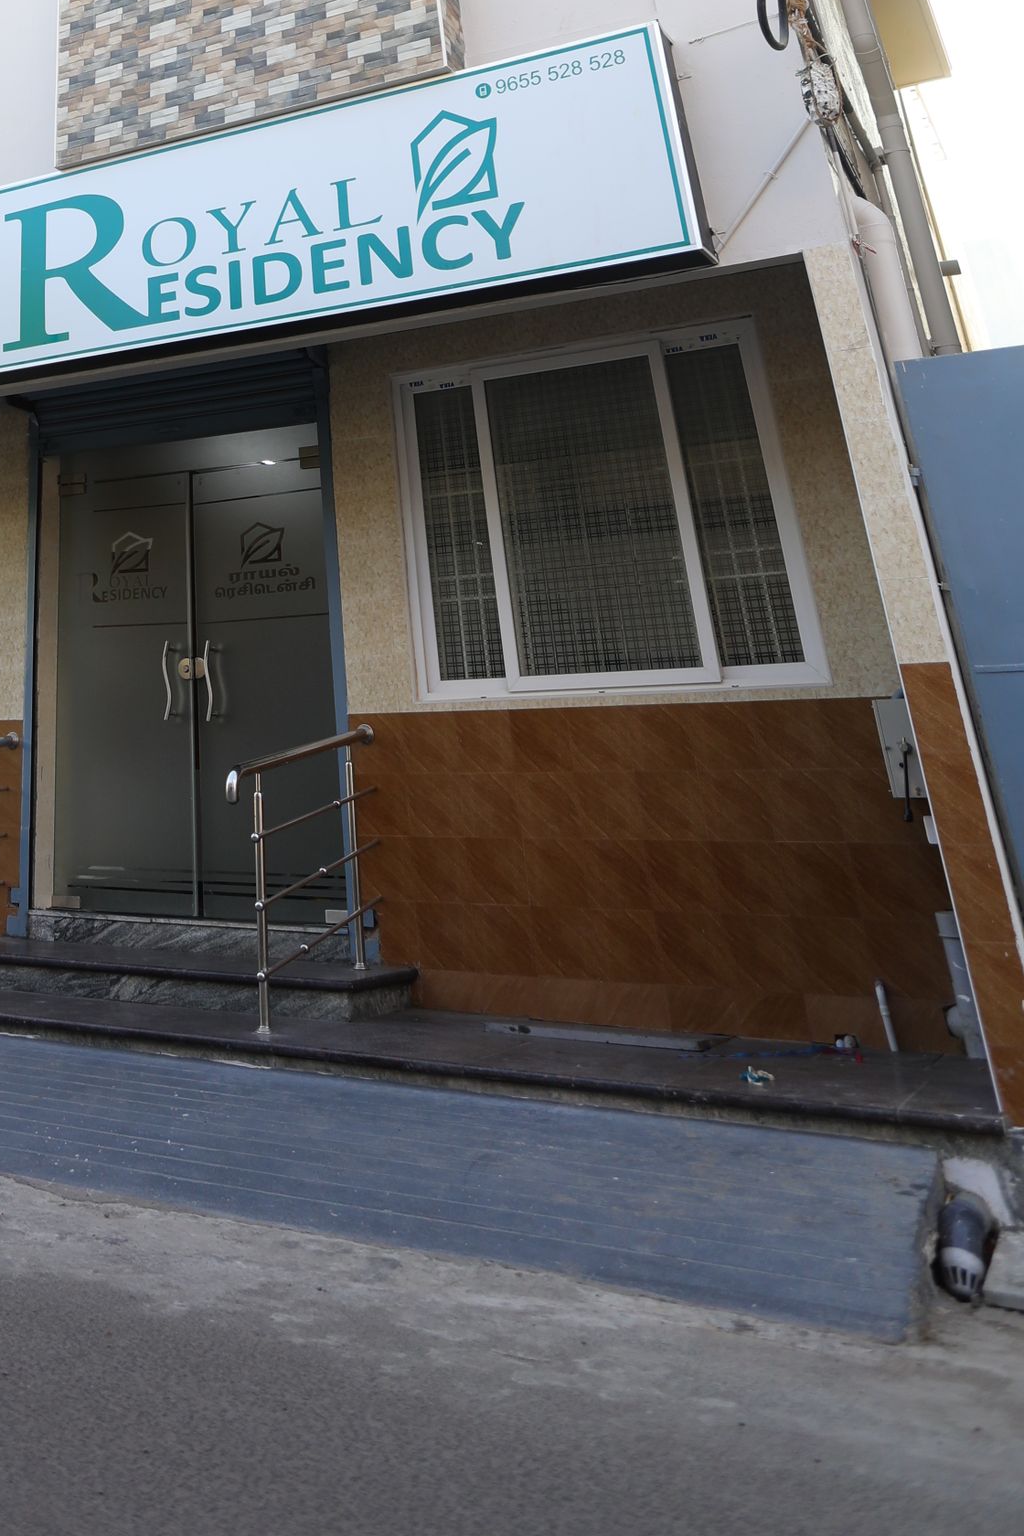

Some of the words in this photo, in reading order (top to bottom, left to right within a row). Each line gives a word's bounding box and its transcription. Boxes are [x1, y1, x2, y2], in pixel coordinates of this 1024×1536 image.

[495, 70, 542, 94] 9655
[548, 60, 583, 81] 528
[589, 49, 626, 71] 528
[2, 176, 383, 352] ROYAL
[228, 563, 301, 584] ராயல்
